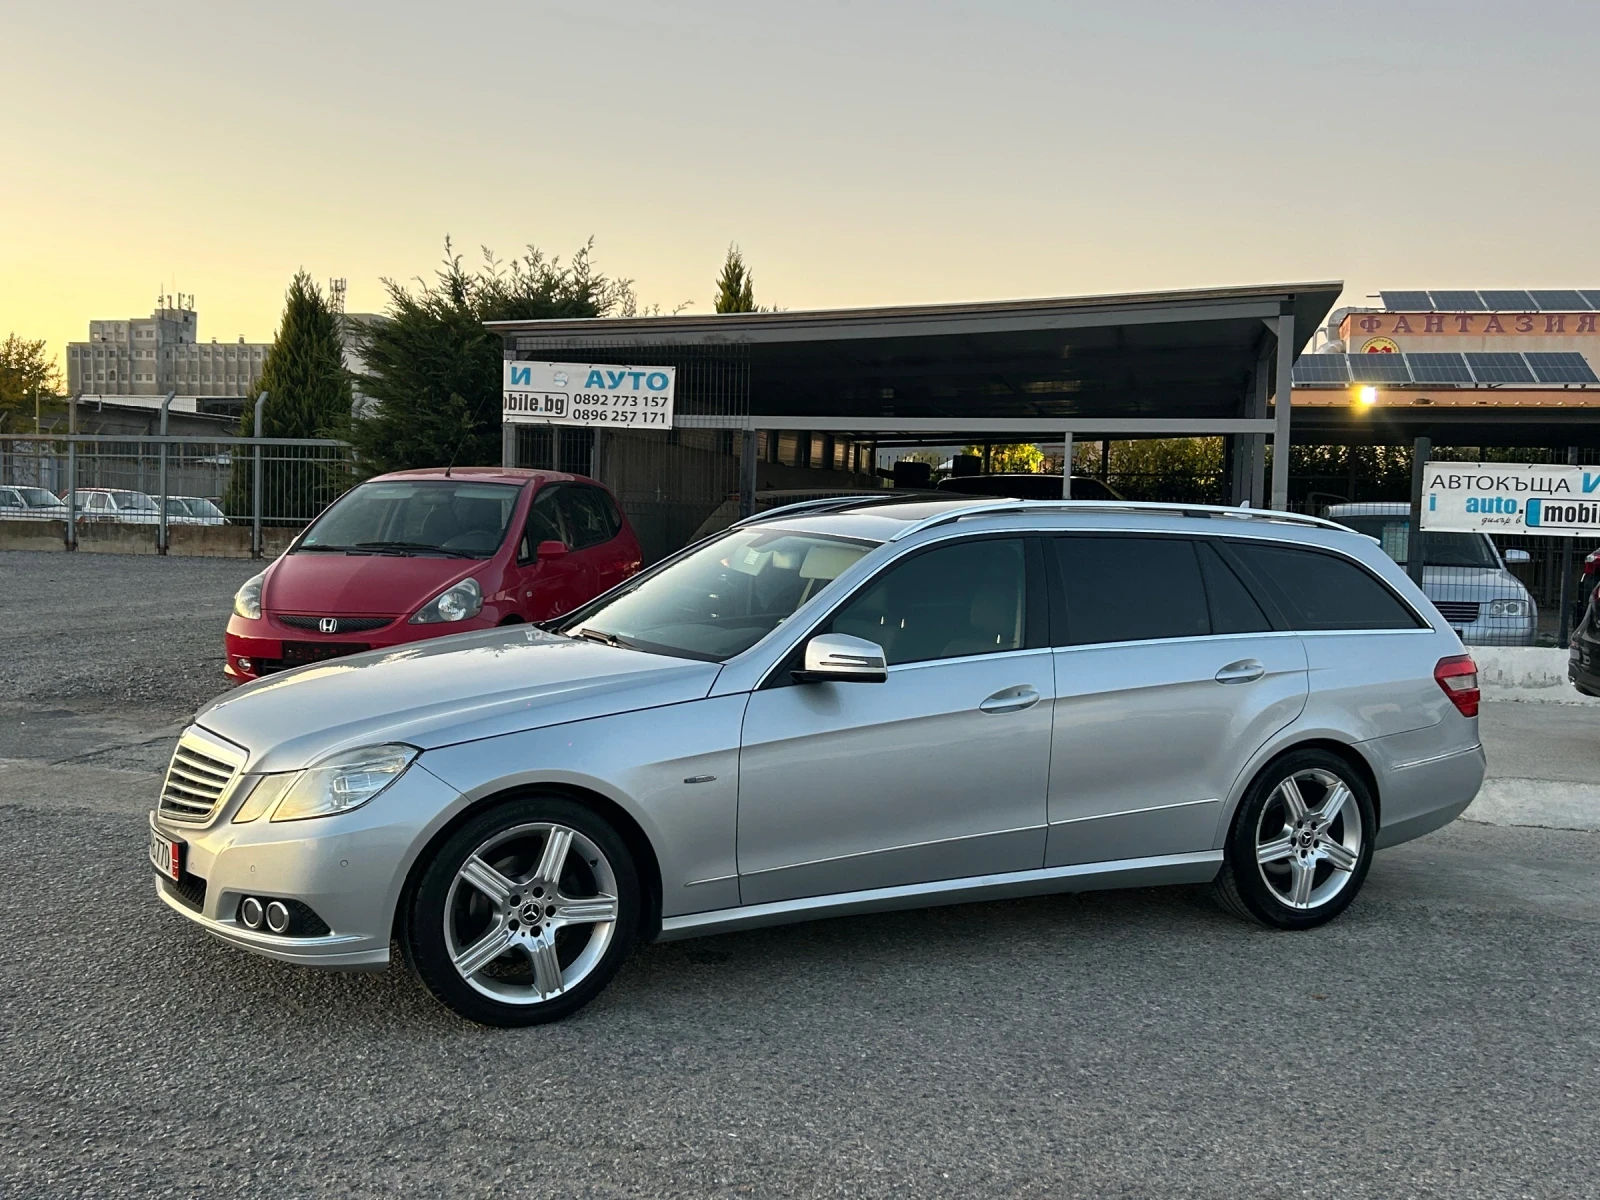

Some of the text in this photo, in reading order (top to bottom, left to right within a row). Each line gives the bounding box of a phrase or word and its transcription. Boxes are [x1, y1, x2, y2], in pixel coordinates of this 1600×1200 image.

[1359, 314, 1597, 334] ФАНТАЗИЯ
[511, 366, 669, 391] И АУТО
[574, 393, 668, 408] 0892 773 157
[573, 409, 665, 424] 0896 257 171
[1430, 474, 1571, 495] АВТОКЪЩА
[1543, 503, 1600, 524] mobi
